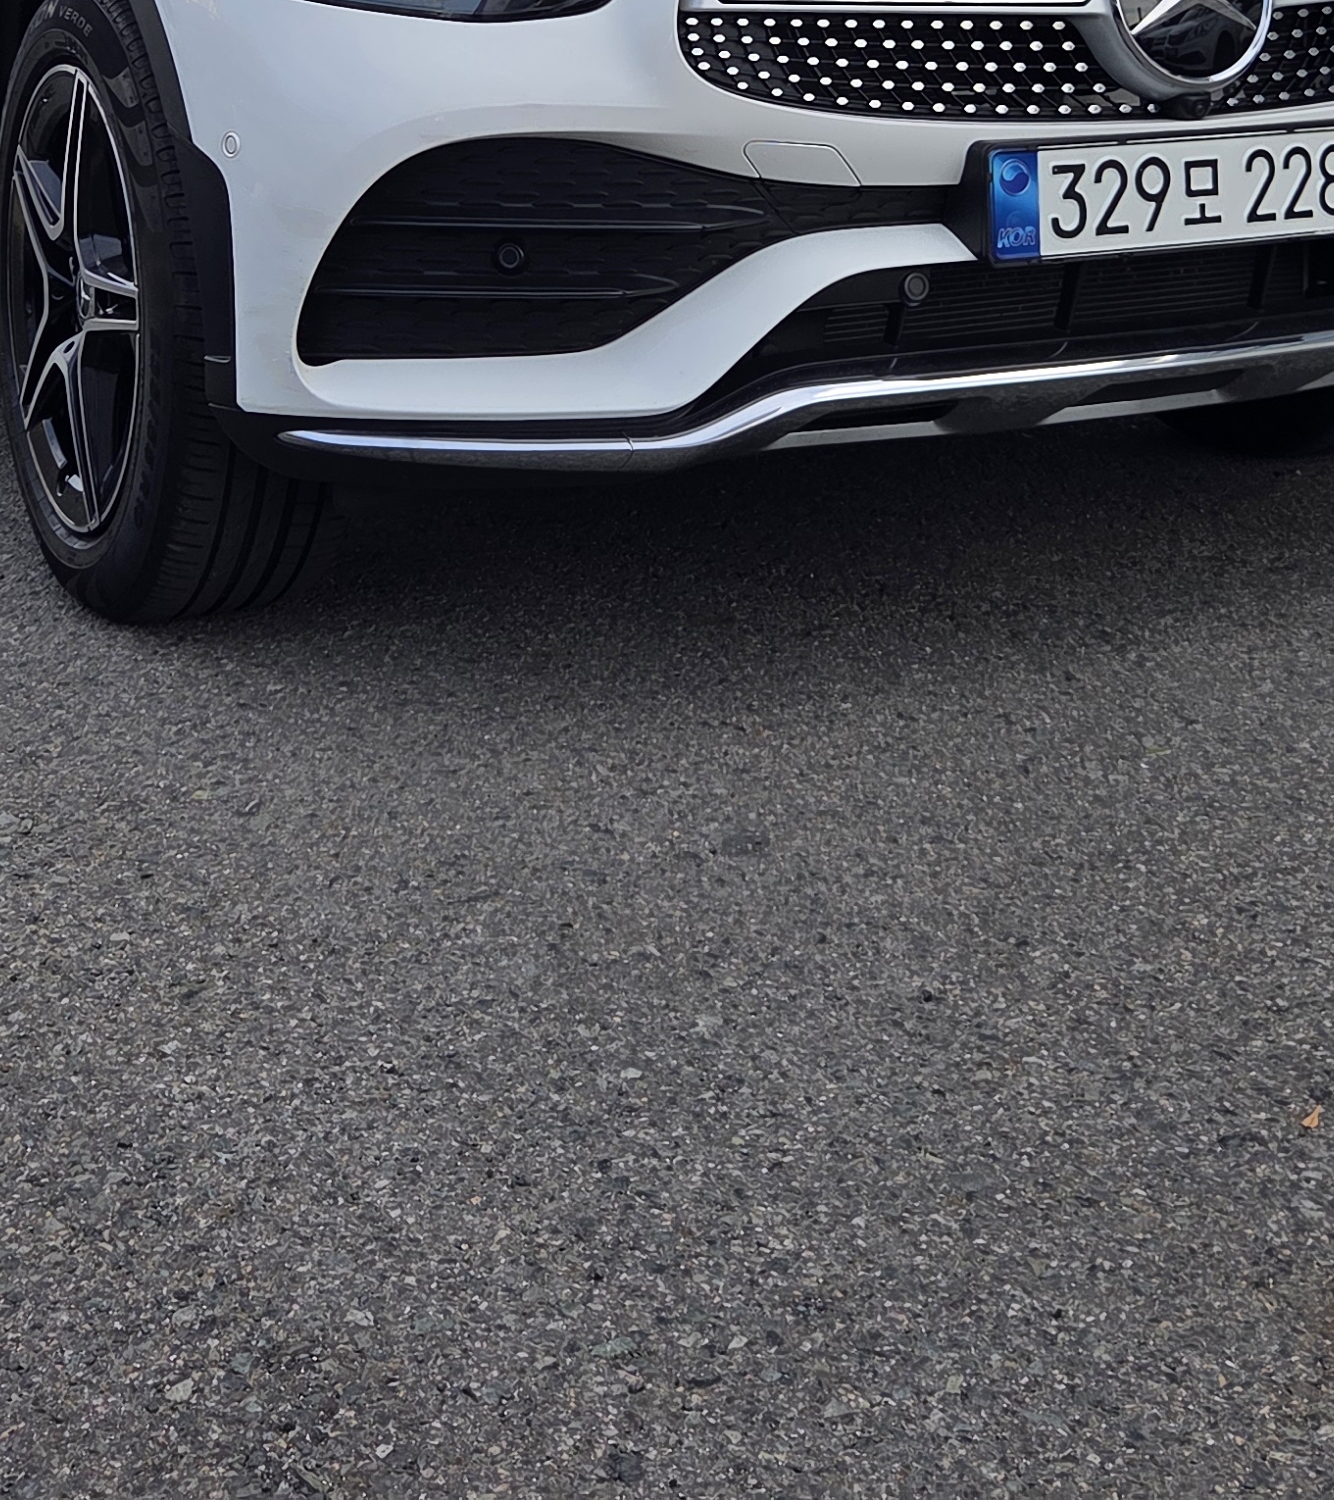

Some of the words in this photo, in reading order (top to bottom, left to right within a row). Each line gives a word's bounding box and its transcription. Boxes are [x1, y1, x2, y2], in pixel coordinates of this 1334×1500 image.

[58, 5, 94, 38] VERDE
[1050, 156, 1222, 239] 329모
[997, 225, 1037, 249] KOR
